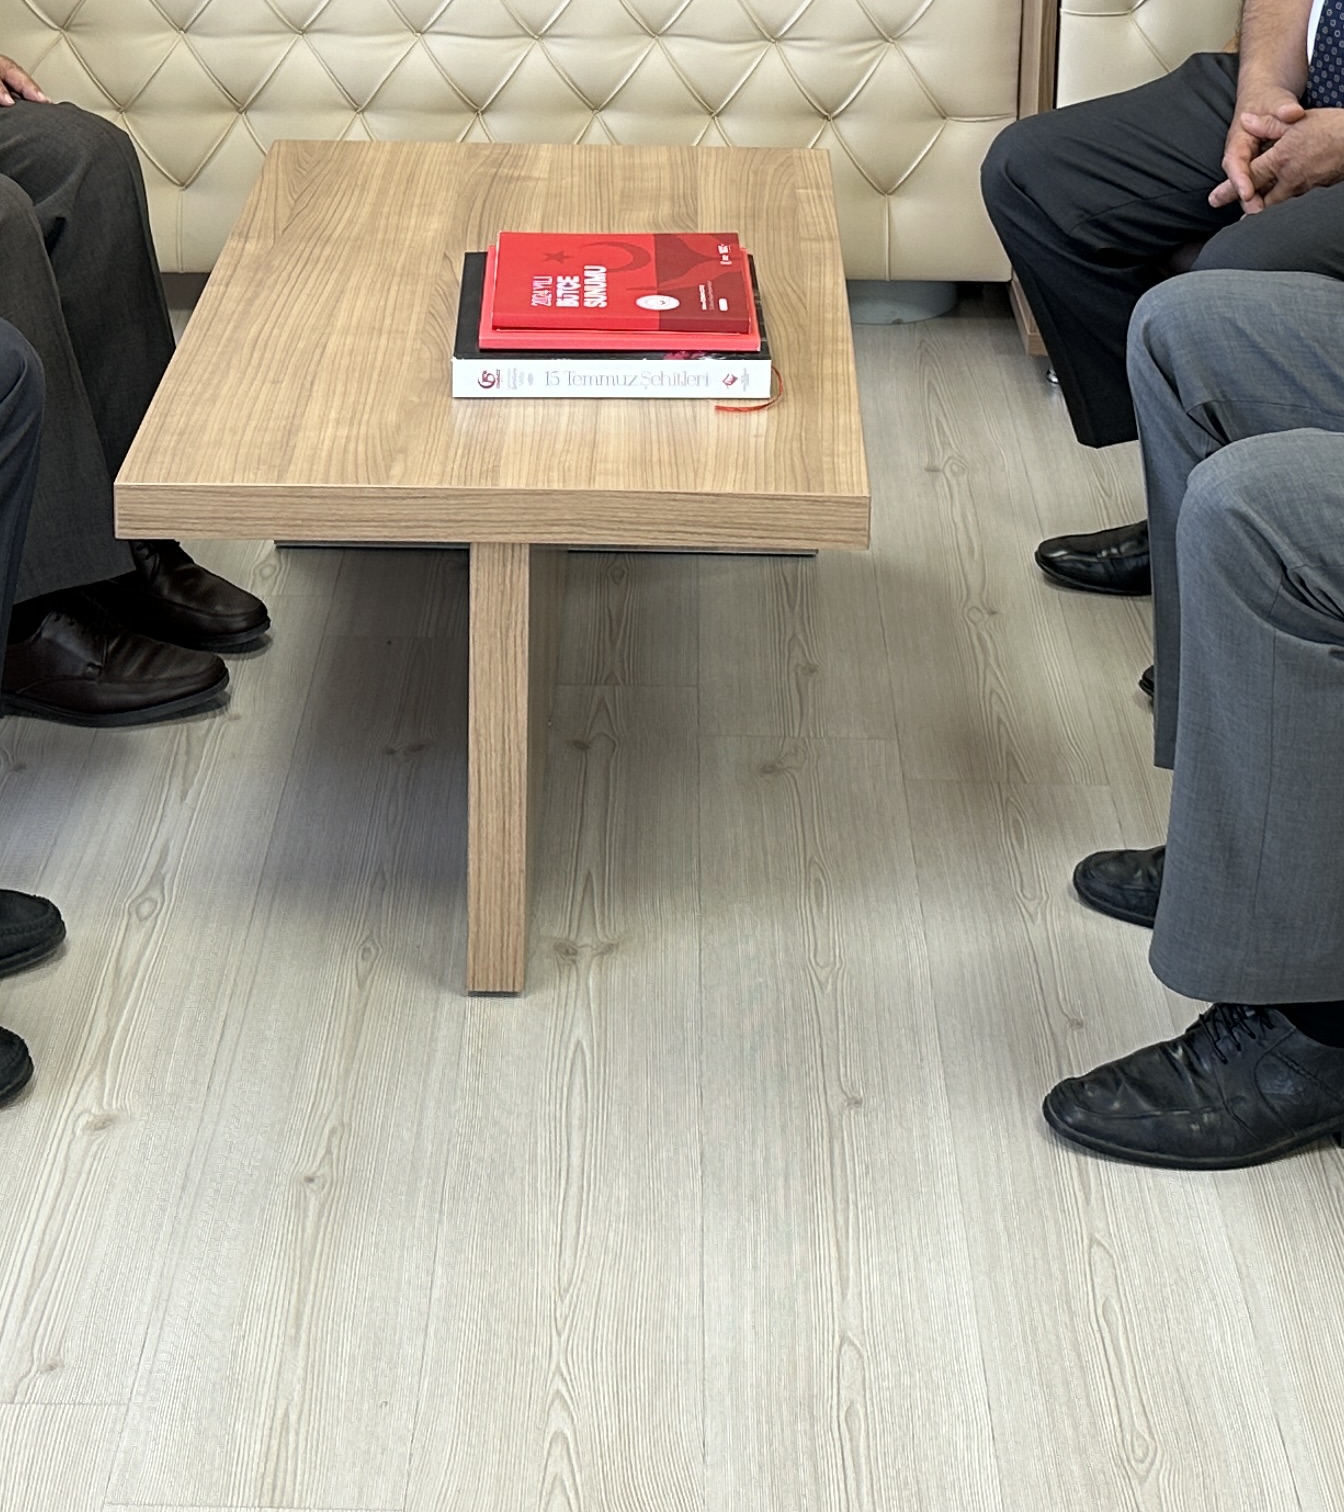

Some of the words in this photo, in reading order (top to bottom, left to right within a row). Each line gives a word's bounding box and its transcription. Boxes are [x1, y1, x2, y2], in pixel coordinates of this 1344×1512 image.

[583, 265, 607, 308] SUNUMU
[545, 370, 560, 386] 15
[564, 370, 638, 386] Temmuz
[640, 369, 709, 389] Şehitleri
